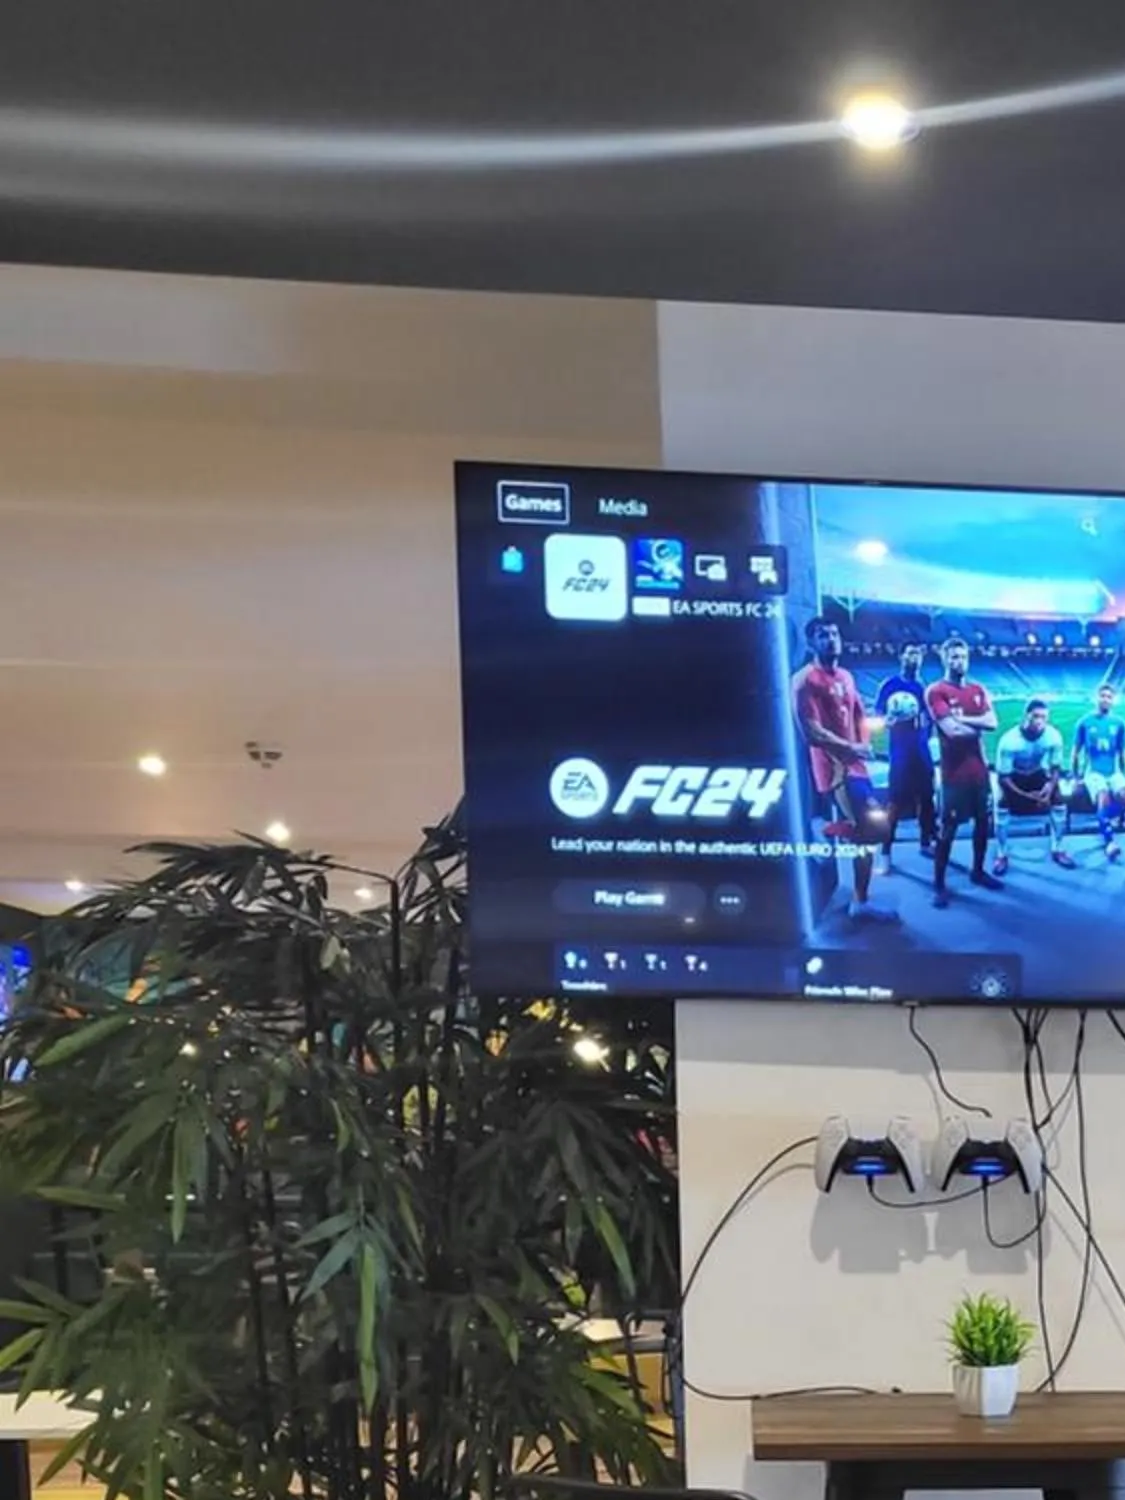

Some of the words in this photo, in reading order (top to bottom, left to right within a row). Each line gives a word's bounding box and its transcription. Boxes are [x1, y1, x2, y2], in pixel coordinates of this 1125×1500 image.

[505, 493, 562, 513] Games
[598, 498, 648, 517] Media
[562, 577, 611, 592] FC24
[673, 600, 691, 615] EA
[694, 600, 742, 617] SPORTS
[745, 603, 761, 618] FC
[563, 771, 597, 791] EA
[612, 765, 788, 818] FC24
[551, 836, 583, 851] Lead
[585, 840, 614, 854] your
[616, 838, 657, 853] nation
[659, 839, 672, 853] in
[674, 839, 697, 854] the
[698, 840, 757, 856] authentic
[760, 842, 794, 858] UEFA
[594, 889, 623, 906] Play
[624, 890, 665, 906] Game
